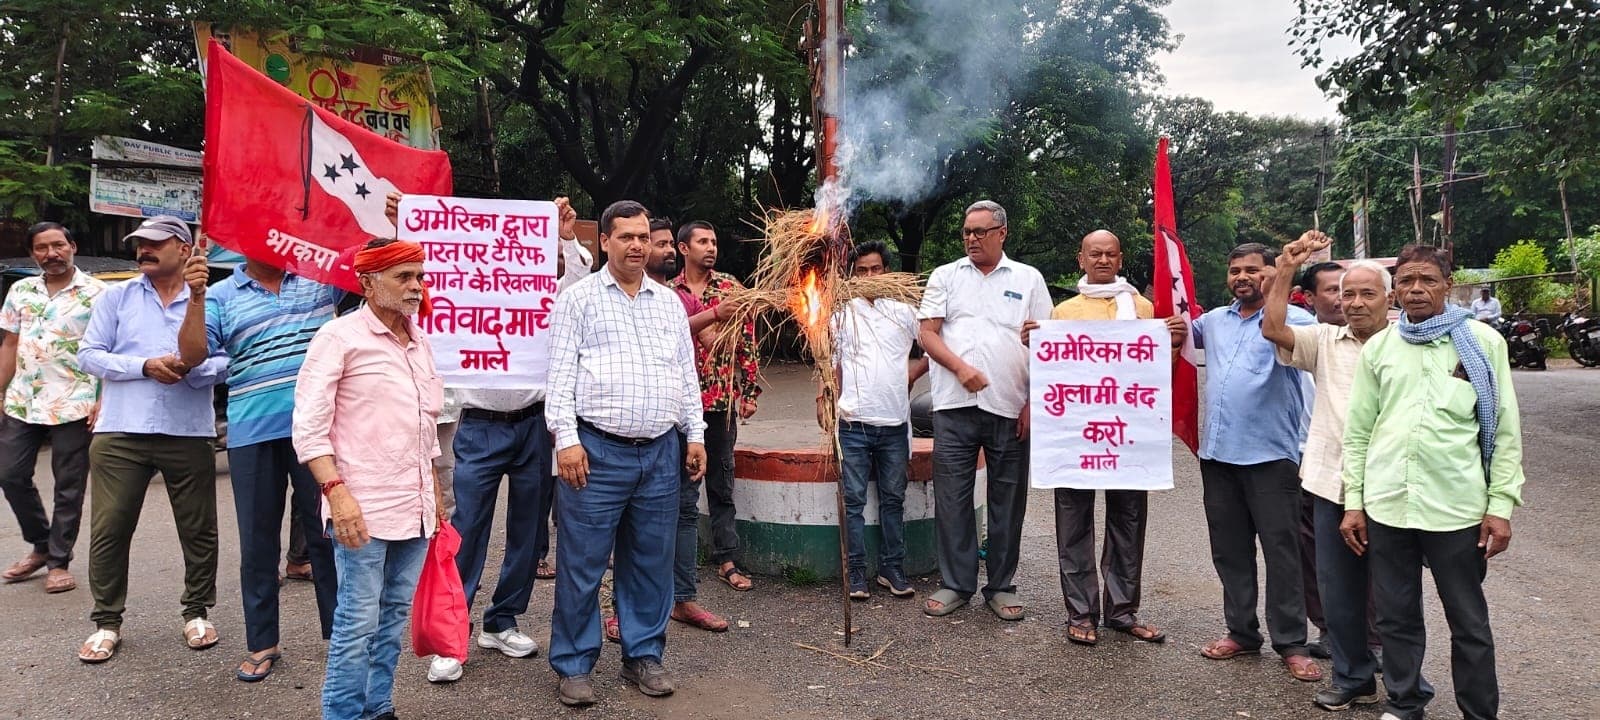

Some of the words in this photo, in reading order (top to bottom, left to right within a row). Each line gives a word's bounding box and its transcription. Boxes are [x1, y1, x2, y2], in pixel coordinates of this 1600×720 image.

[124, 141, 141, 149] DAV
[143, 145, 171, 155] PUBLIC
[405, 199, 499, 232] अमेरिका
[502, 214, 550, 239] द्वारा
[266, 228, 340, 272] भाकपा
[420, 241, 462, 263] ारत
[463, 242, 489, 265] पर
[491, 237, 546, 267] टैरिफ
[423, 265, 469, 292] गाने
[468, 267, 492, 293] के
[416, 296, 504, 340] तिवाद
[504, 297, 555, 337] मार्च
[459, 341, 511, 371] माले
[1036, 333, 1124, 363] अमेरिका
[1126, 335, 1160, 363] की
[1043, 376, 1120, 417] गुलामी
[1123, 383, 1161, 409] बंद
[1079, 448, 1120, 470] माले
